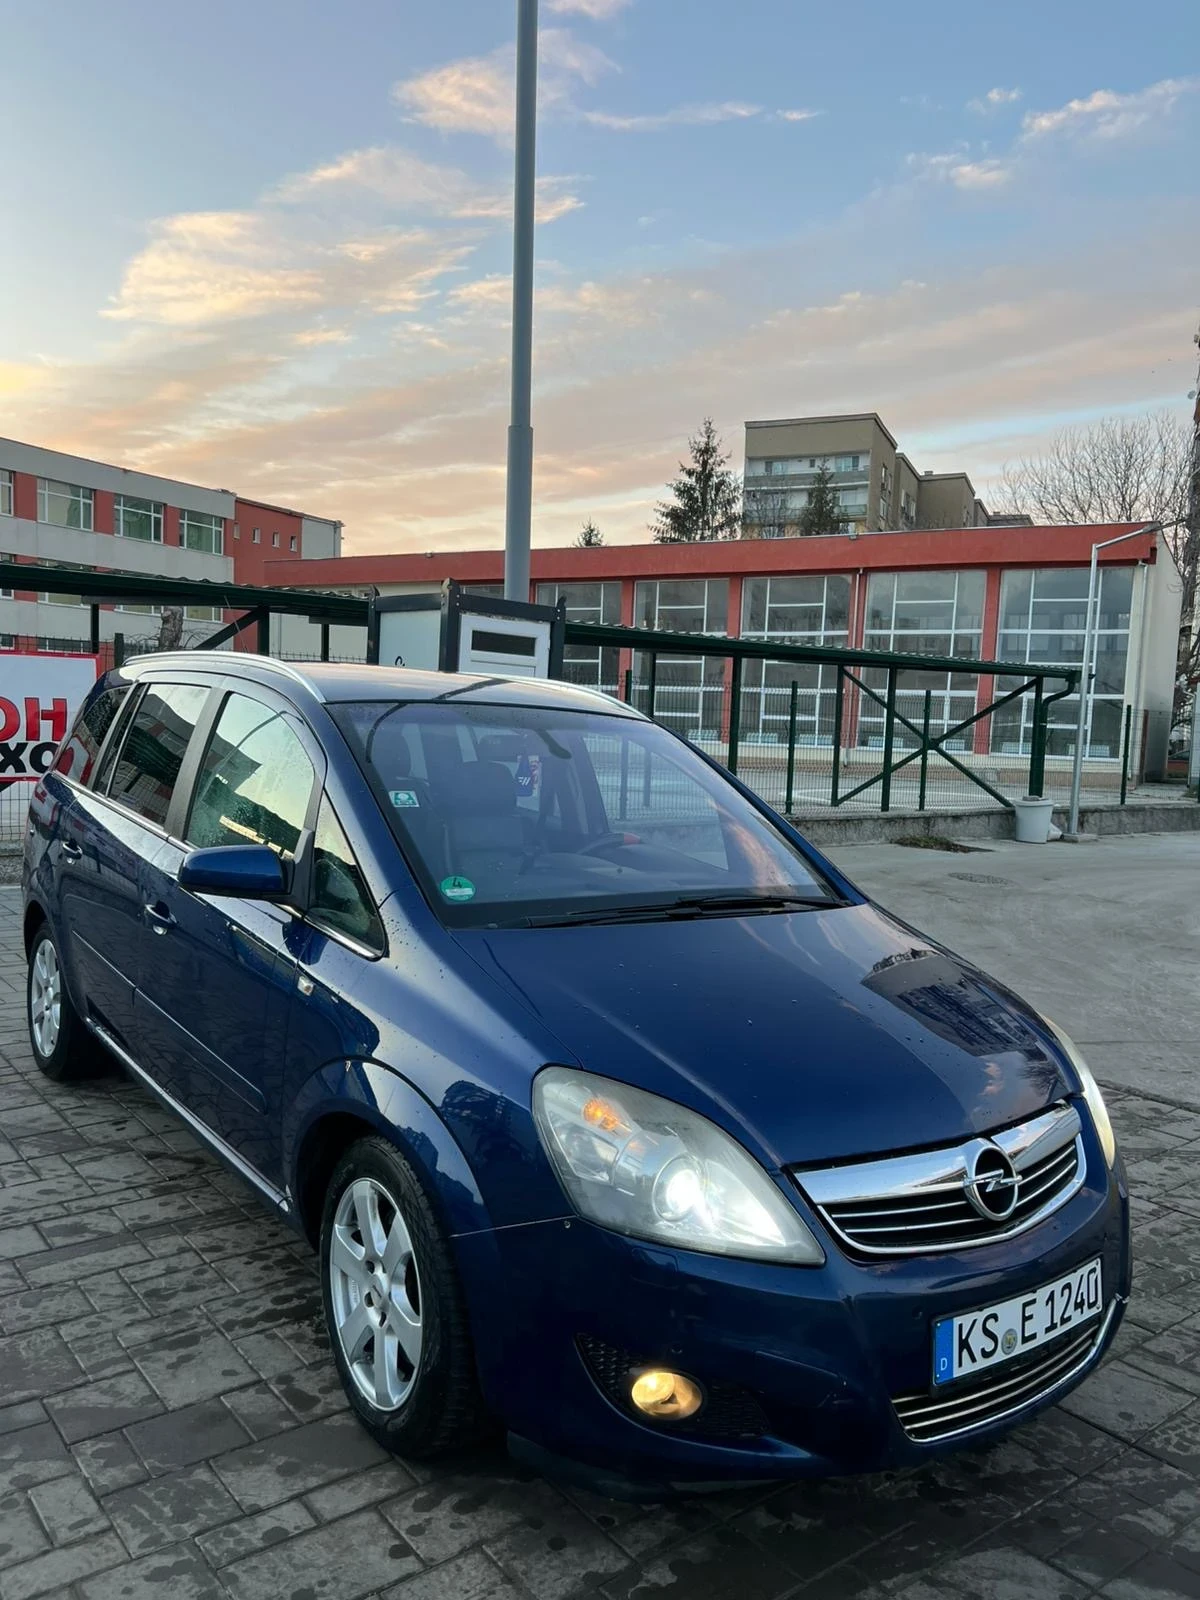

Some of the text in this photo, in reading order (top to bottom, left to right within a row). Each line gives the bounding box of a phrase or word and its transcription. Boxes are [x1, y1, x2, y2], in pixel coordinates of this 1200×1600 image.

[452, 877, 462, 888] 4
[958, 1267, 1098, 1368] KS E 1240
[940, 1357, 948, 1371] D
